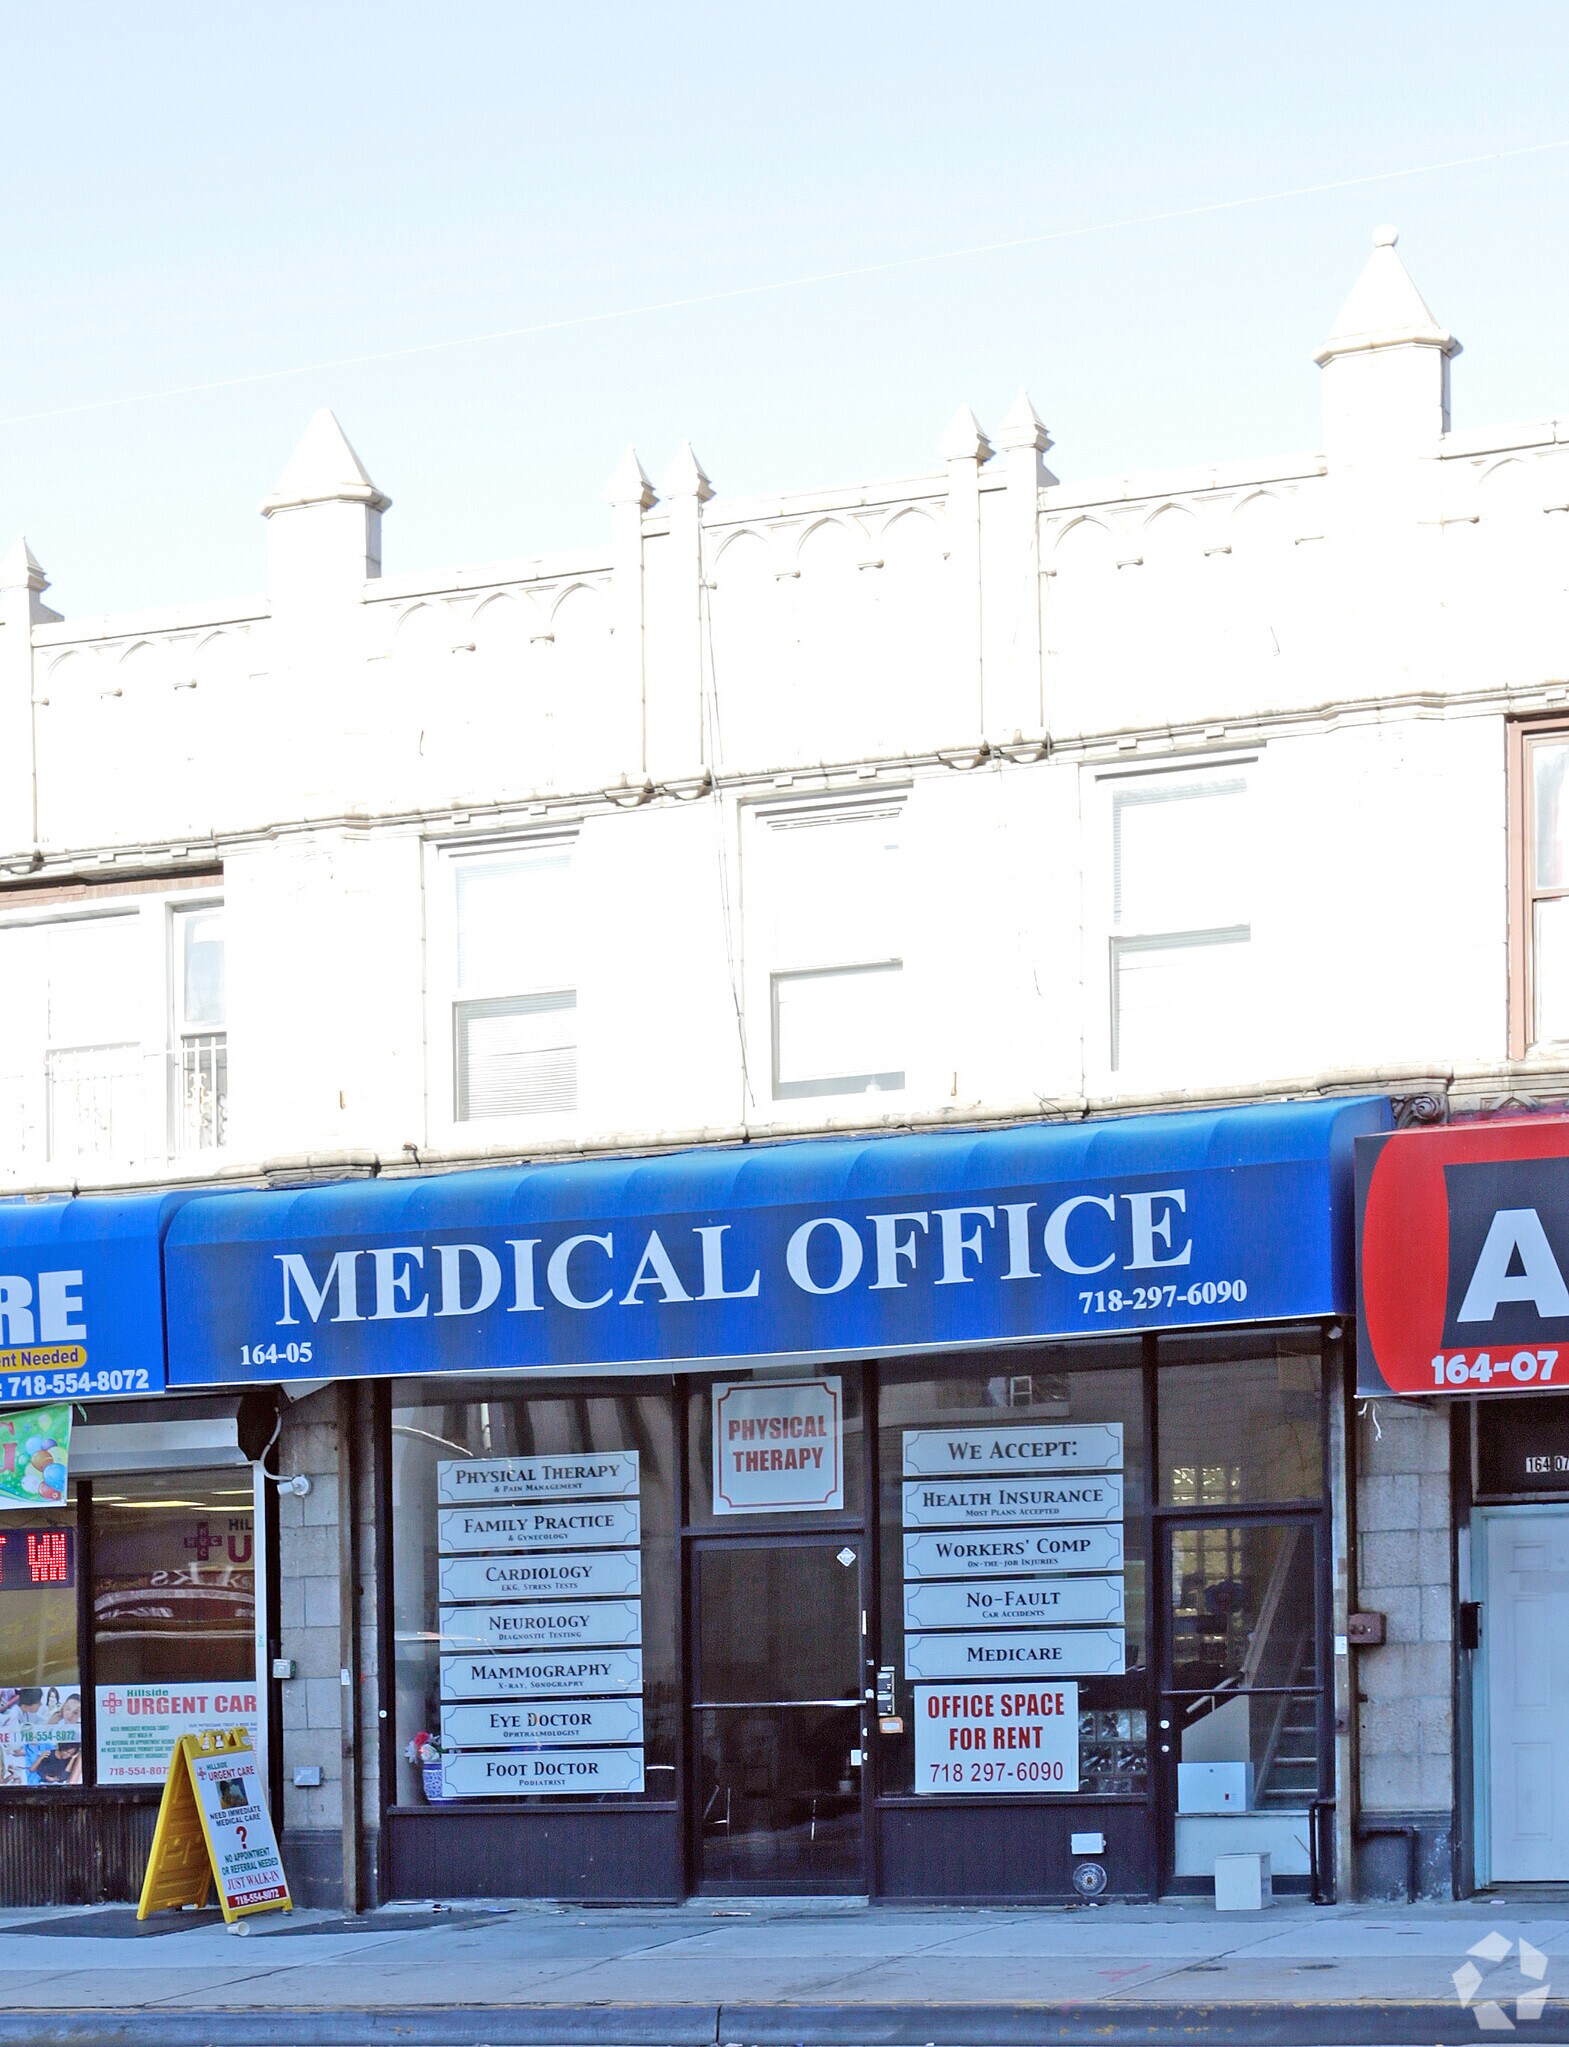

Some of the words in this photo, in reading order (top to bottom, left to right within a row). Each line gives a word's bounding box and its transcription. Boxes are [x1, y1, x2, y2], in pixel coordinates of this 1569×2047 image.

[273, 1224, 760, 1326] MEDICAL
[786, 1188, 1192, 1295] OFFICE
[1078, 1279, 1248, 1314] 718-297-6090
[21, 1348, 78, 1367] Needed
[240, 1341, 313, 1366] 164-05
[1431, 1350, 1559, 1385] 164-07
[8, 1369, 149, 1397] 718-554-8072
[728, 1415, 827, 1442] PHYSICAL
[948, 1441, 982, 1460] WE
[990, 1440, 1078, 1459] ACCEPT:
[733, 1447, 823, 1473] THERAPY
[1529, 1457, 1550, 1472] 164
[455, 1468, 536, 1484] PHYSICAL
[542, 1464, 621, 1480] THERAPY
[503, 1485, 523, 1493] PAIN
[525, 1482, 582, 1492] MANAGEMENT
[923, 1490, 991, 1507] HEALTH
[999, 1488, 1104, 1505] INSURANCE
[965, 1509, 988, 1517] MOST
[990, 1508, 1016, 1516] PLANS
[1019, 1507, 1060, 1515] ACCEPTED
[464, 1518, 528, 1533] FAMILY
[534, 1514, 615, 1530] PRACTICE
[517, 1533, 569, 1541] GYNECOLOGY
[936, 1539, 1030, 1558] WORKERS'
[1036, 1537, 1091, 1553] COMP
[1021, 1557, 1059, 1566] INJURIES
[485, 1566, 593, 1582] CARDIOLOGY
[523, 1583, 552, 1591] STRESS
[555, 1582, 578, 1590] TESTS
[966, 1591, 1061, 1607] NO-FAULT
[489, 1615, 590, 1631] NEUROLOGY
[982, 1611, 999, 1619] CAR
[498, 1632, 545, 1640] DIAGNOSTIC
[549, 1631, 582, 1639] TESTING
[967, 1647, 1062, 1662] MEDICARE
[471, 1663, 612, 1680] MAMMOGRAPHY
[530, 1680, 584, 1688] SONOGRAPHY
[127, 1696, 208, 1715] URGENT
[214, 1695, 257, 1713] CAR
[927, 1694, 995, 1718] OFFICE
[1001, 1693, 1065, 1717] SPACE
[490, 1713, 520, 1728] EYE
[527, 1712, 592, 1726] DOCTOR
[949, 1727, 986, 1750] FOR
[993, 1726, 1043, 1750] RENT
[208, 1768, 236, 1781] URGENT
[237, 1765, 255, 1776] CARE
[486, 1762, 528, 1777] FOOT
[534, 1761, 599, 1775] DOCTOR
[929, 1763, 963, 1782] 718
[971, 1761, 1064, 1782] 297-6090
[519, 1778, 566, 1787] PODIATRIST
[210, 1810, 227, 1820] NEED
[228, 1805, 261, 1817] IMMEDIATE
[216, 1815, 244, 1827] MEDICAL
[244, 1813, 261, 1822] CARE
[236, 1826, 248, 1849] ?
[224, 1854, 233, 1863] NO
[234, 1847, 270, 1860] APPOINTMENT
[221, 1866, 231, 1876] OR
[231, 1861, 257, 1874] REFERRAL
[258, 1857, 279, 1870] NEEDED
[227, 1877, 246, 1890] JUST
[246, 1869, 280, 1887] WALK-IN
